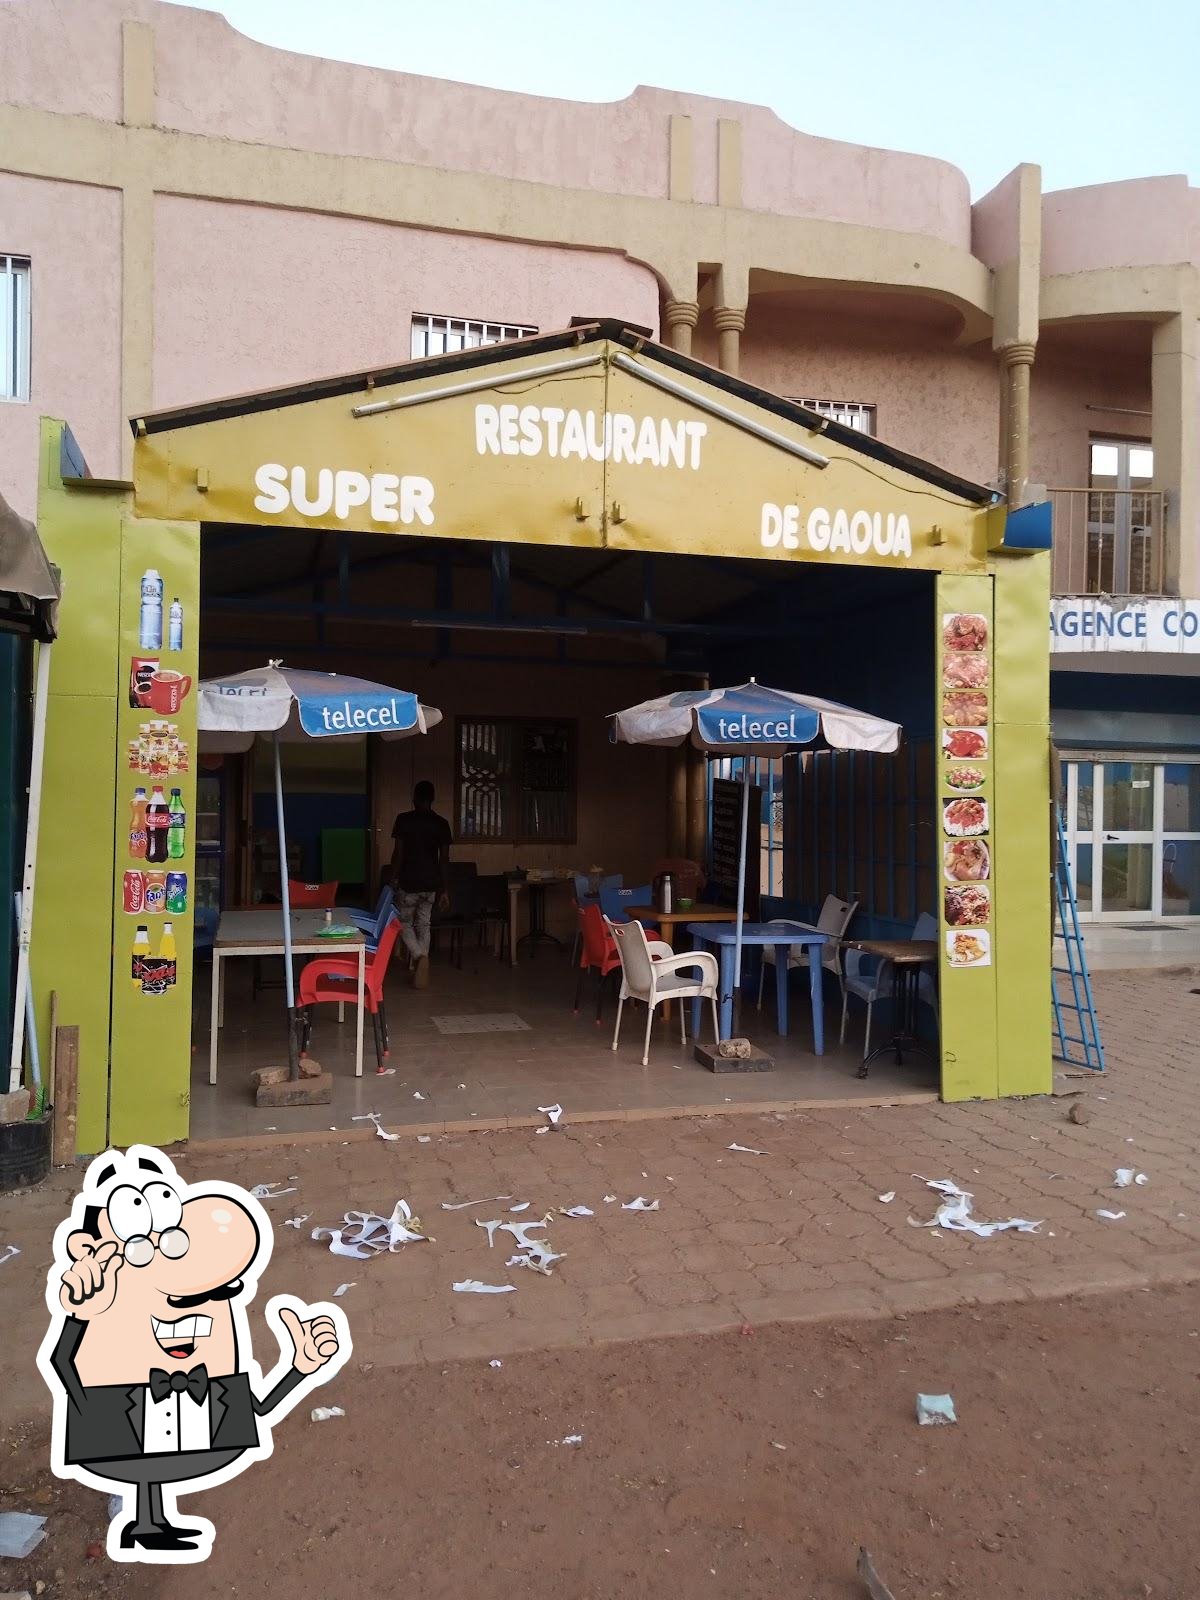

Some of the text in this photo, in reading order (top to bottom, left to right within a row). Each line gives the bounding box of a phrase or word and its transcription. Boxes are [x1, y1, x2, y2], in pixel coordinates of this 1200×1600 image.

[473, 403, 708, 472] RESTAURANT
[254, 462, 436, 526] SUPER
[760, 502, 913, 557] DE GAOUA
[1162, 610, 1199, 638] CO
[322, 698, 401, 731] telecel
[718, 714, 797, 739] telecel
